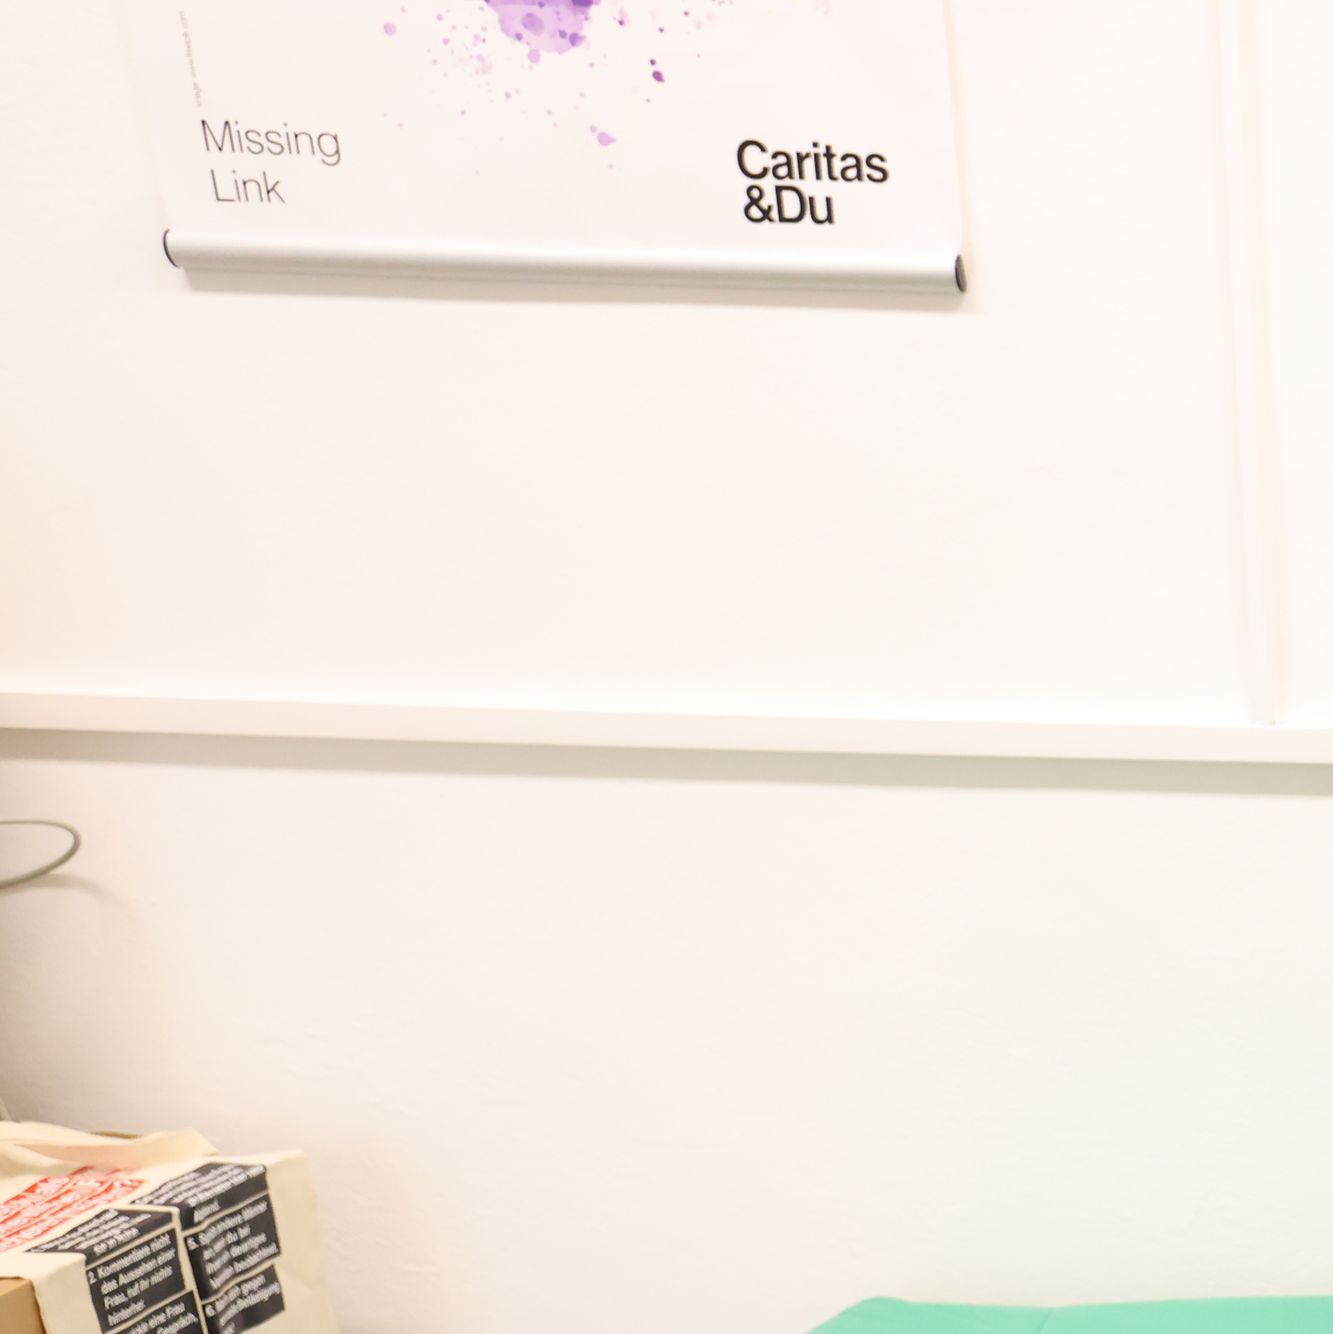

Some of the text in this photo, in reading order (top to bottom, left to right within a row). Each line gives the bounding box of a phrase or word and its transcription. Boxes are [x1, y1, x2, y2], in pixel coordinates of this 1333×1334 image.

[200, 119, 342, 167] Missing
[737, 140, 890, 183] Caritas
[210, 168, 287, 204] Link
[743, 185, 835, 225] &Du
